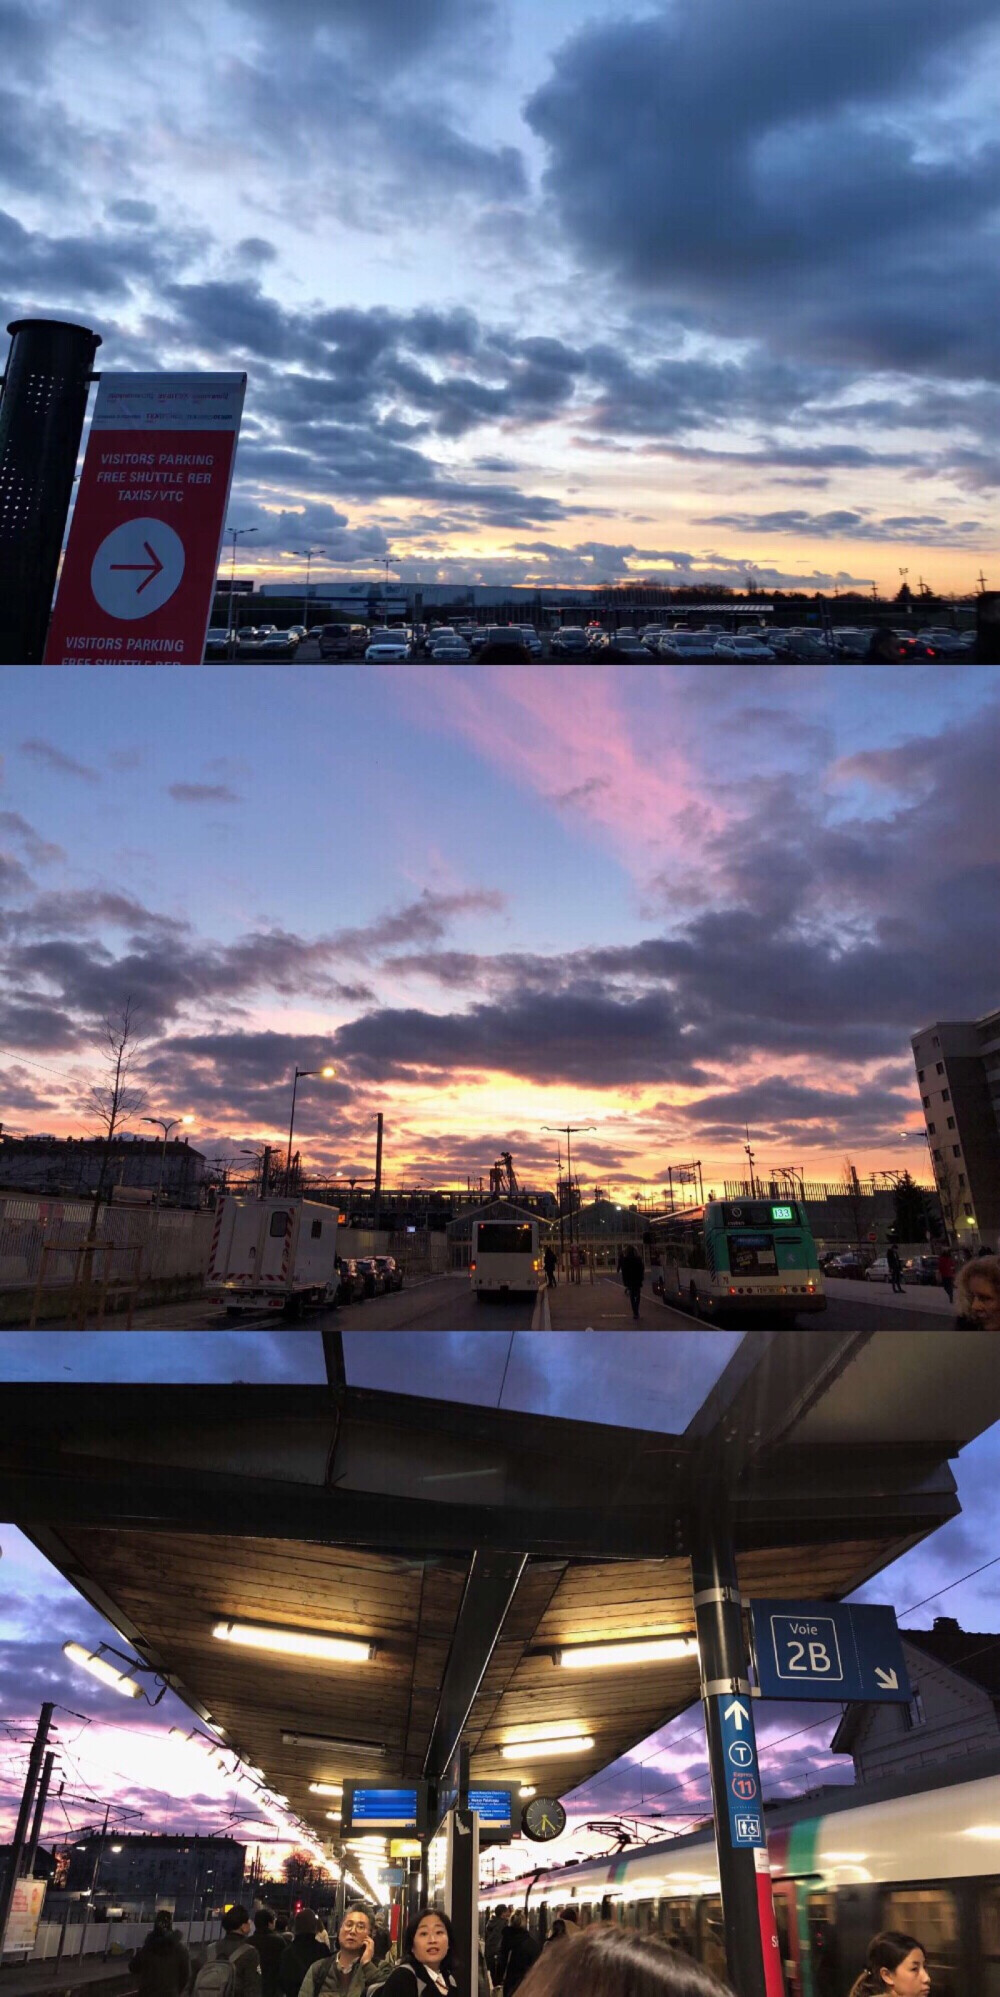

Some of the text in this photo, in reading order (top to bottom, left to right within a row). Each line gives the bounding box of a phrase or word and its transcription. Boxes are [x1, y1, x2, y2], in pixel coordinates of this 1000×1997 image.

[101, 453, 214, 466] VISITORS PARKING
[97, 471, 212, 484] FREE SHUTTLE RER
[66, 636, 184, 652] VISITORS PARKING
[774, 1208, 790, 1218] 133
[789, 1623, 818, 1635] Voie
[787, 1641, 831, 1672] 2B
[738, 1780, 752, 1794] 11
